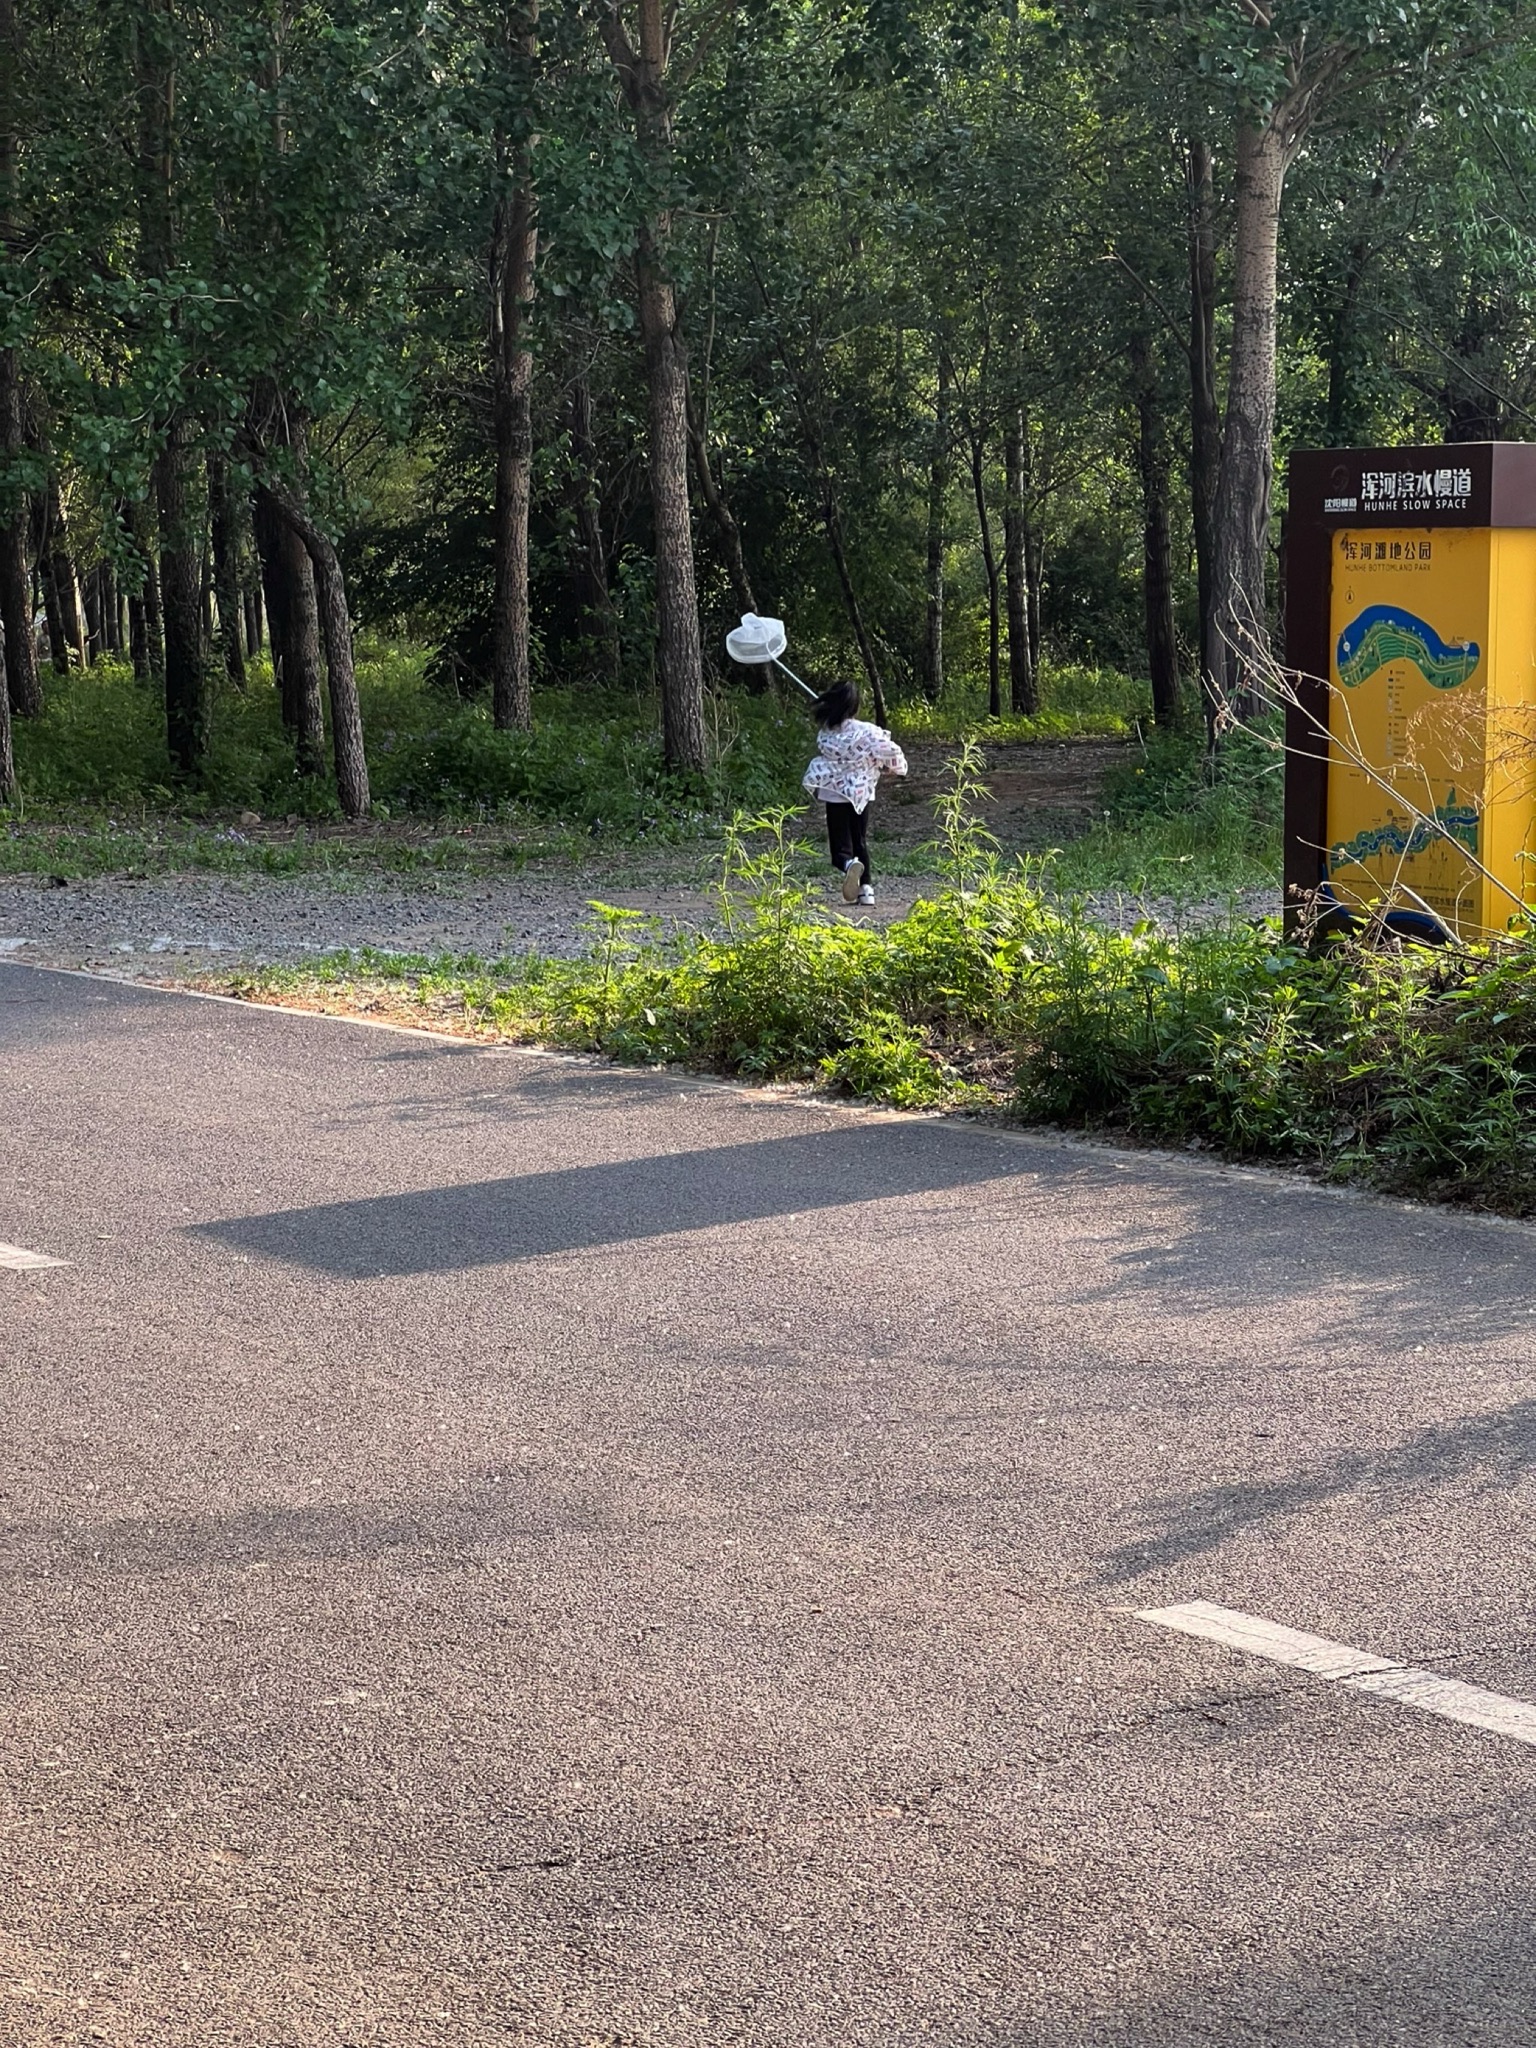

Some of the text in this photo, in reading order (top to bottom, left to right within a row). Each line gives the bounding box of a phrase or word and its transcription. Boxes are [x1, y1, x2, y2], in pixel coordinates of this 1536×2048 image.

[1364, 499, 1467, 511] HUNHE SLOW SPACE
[1414, 563, 1431, 571] PARK
